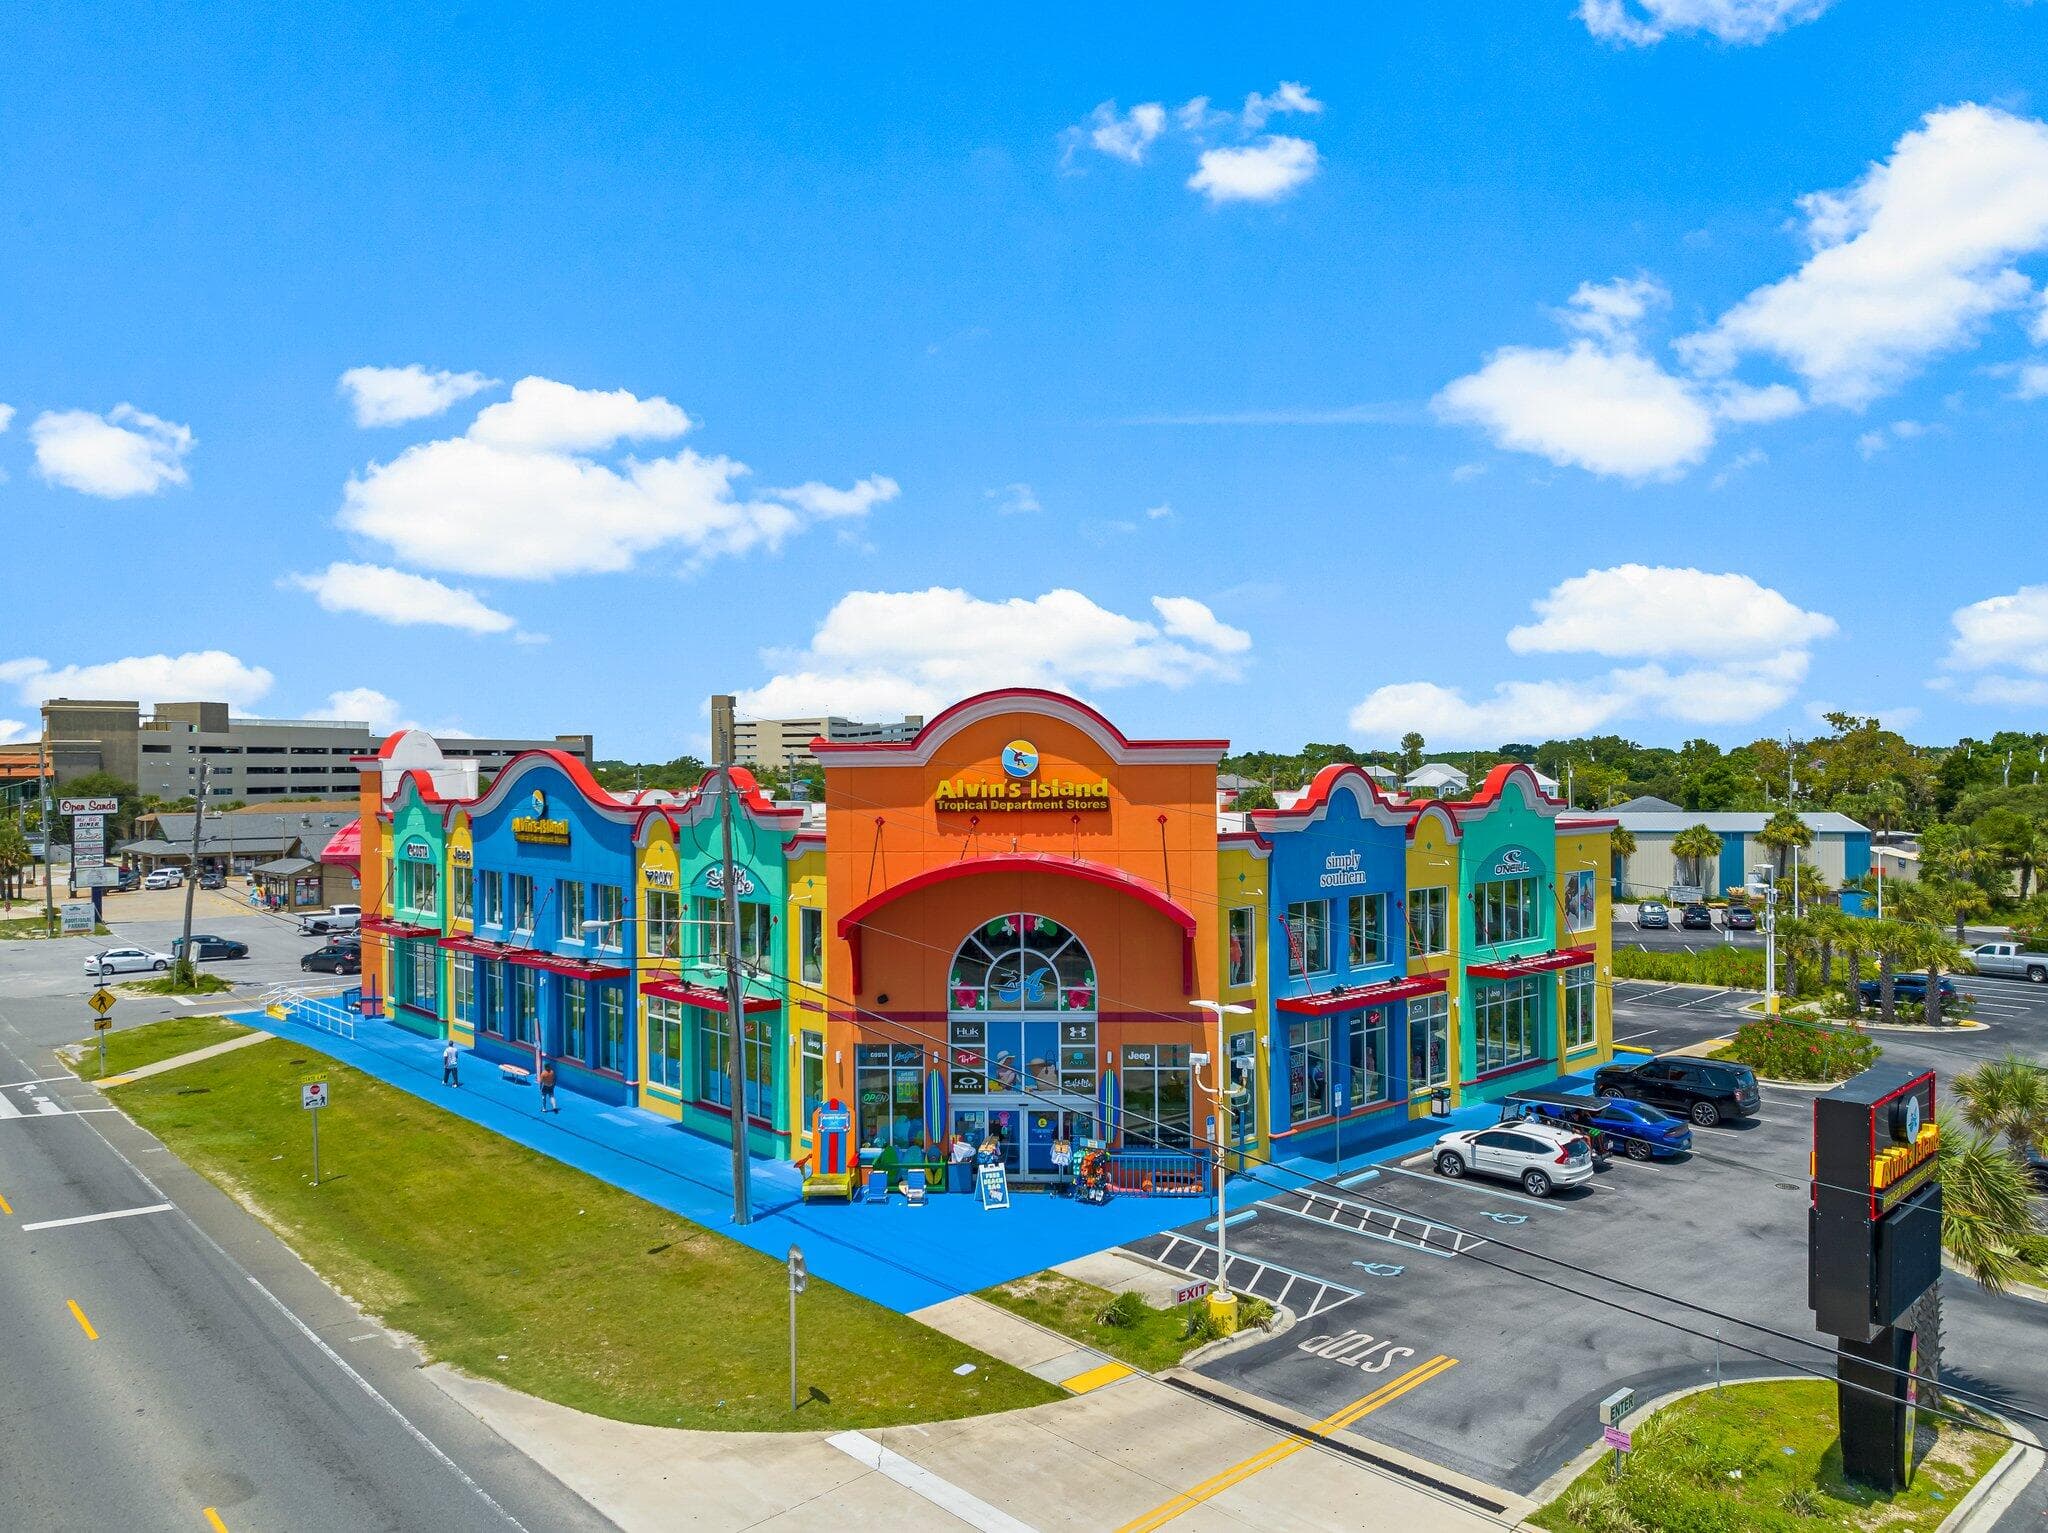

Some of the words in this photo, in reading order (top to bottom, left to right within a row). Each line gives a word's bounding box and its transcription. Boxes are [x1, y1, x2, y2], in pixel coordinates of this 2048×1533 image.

[935, 779, 1022, 798] Alvin's
[1030, 778, 1108, 798] Island
[61, 801, 86, 814] Open
[88, 800, 117, 811] Sands
[936, 800, 988, 812] Tropical
[990, 800, 1064, 812] Department
[1066, 799, 1108, 810] Stores
[453, 846, 472, 864] Jeep
[1325, 849, 1362, 871] simply
[654, 869, 675, 886] ROXY
[1319, 870, 1367, 888] southern
[1127, 1050, 1151, 1061] Jeep
[863, 1092, 890, 1103] OPEN
[1178, 1283, 1207, 1303] EXIT
[1297, 1329, 1415, 1373] STOP
[1610, 1394, 1635, 1421] ENTER
